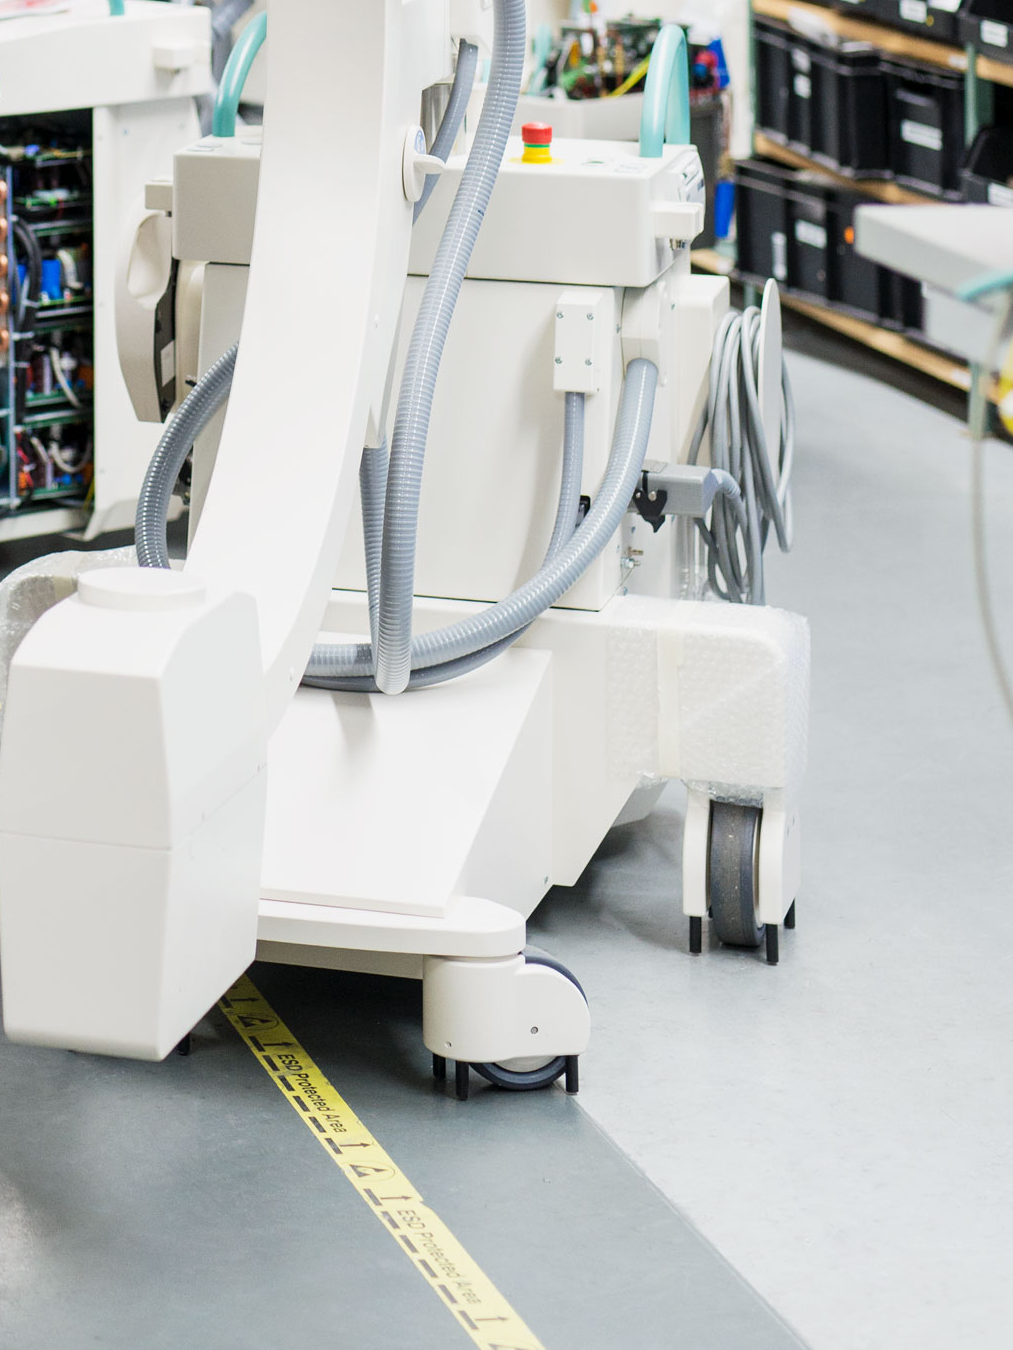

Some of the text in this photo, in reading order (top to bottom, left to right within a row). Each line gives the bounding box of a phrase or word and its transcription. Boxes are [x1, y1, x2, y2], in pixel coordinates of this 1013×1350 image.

[277, 1053, 347, 1133] ESD Protected Area
[396, 1209, 482, 1304] ESD Protected Area
